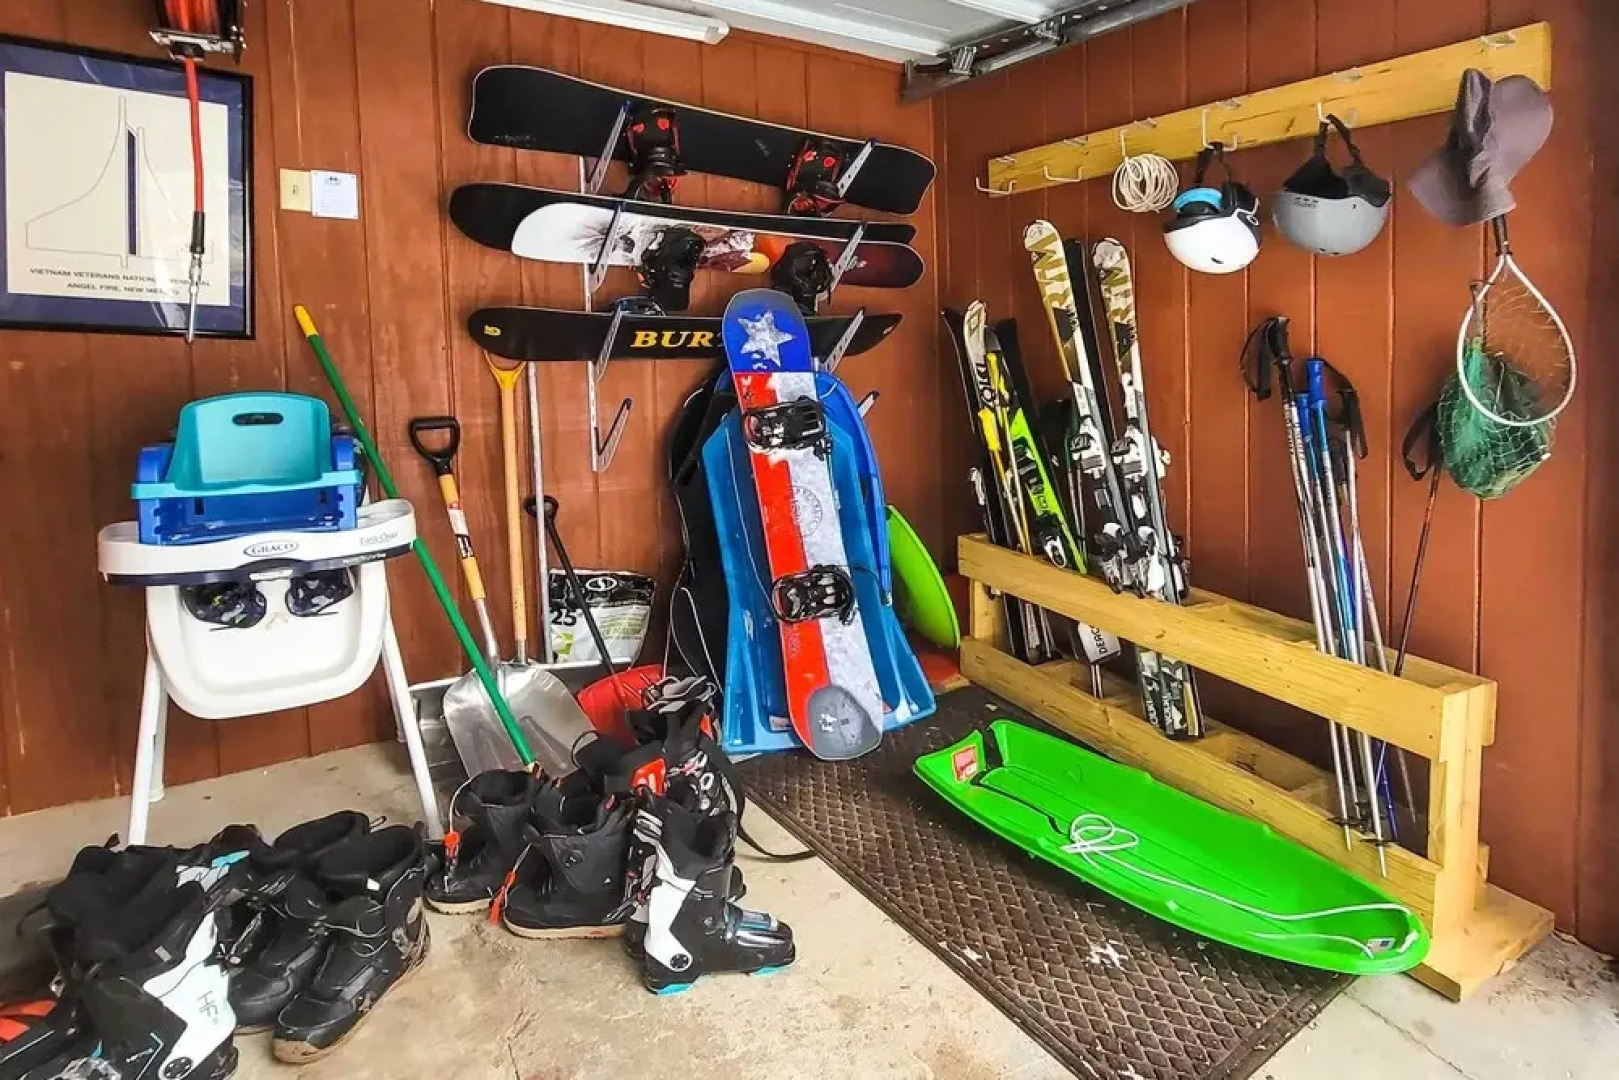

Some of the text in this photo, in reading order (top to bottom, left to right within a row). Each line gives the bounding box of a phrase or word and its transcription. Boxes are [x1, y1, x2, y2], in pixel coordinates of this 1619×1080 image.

[30, 268, 71, 277] VIETNAM
[73, 271, 120, 281] VETERANS
[67, 282, 97, 291] ANGEL
[630, 331, 723, 348] BUR
[251, 543, 294, 554] GRACO
